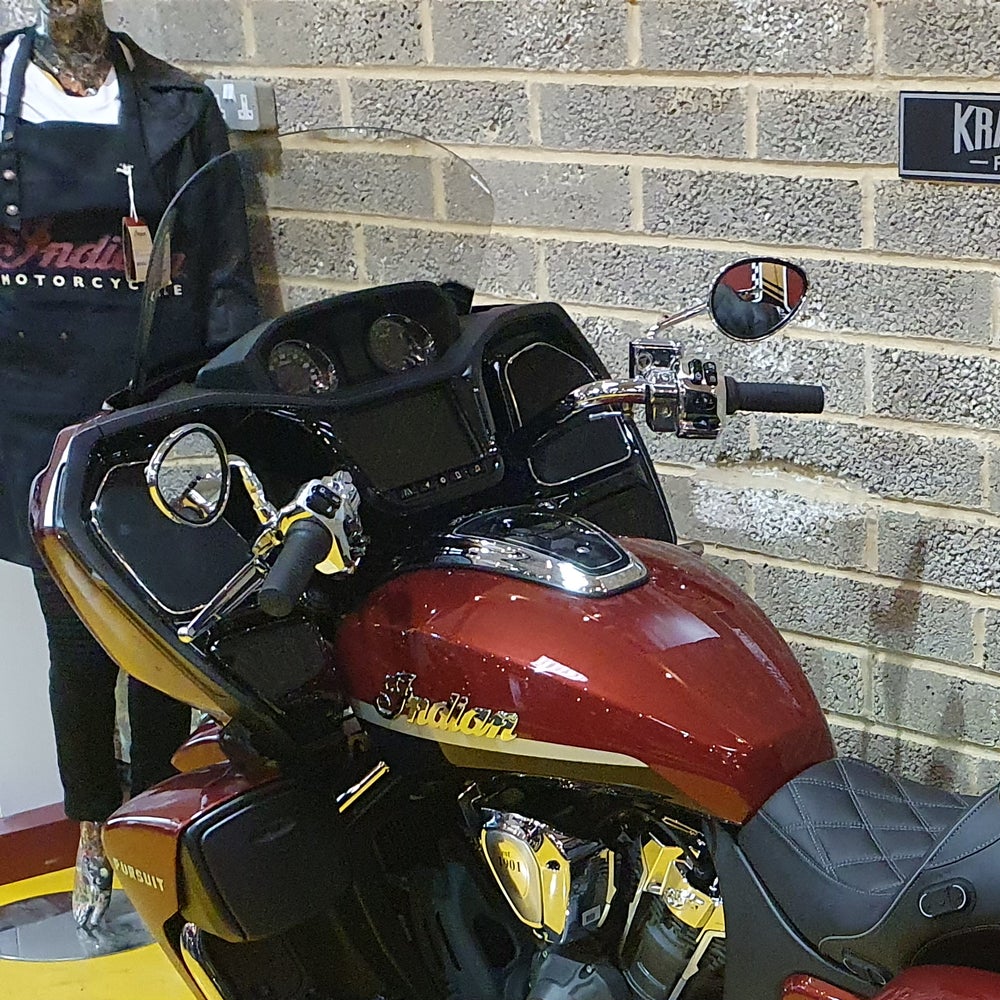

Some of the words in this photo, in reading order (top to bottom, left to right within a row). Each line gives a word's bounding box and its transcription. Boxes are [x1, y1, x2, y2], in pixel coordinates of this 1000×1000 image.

[376, 671, 519, 741] Indian
[112, 857, 164, 892] PURSUIT
[498, 856, 521, 872] 1901
